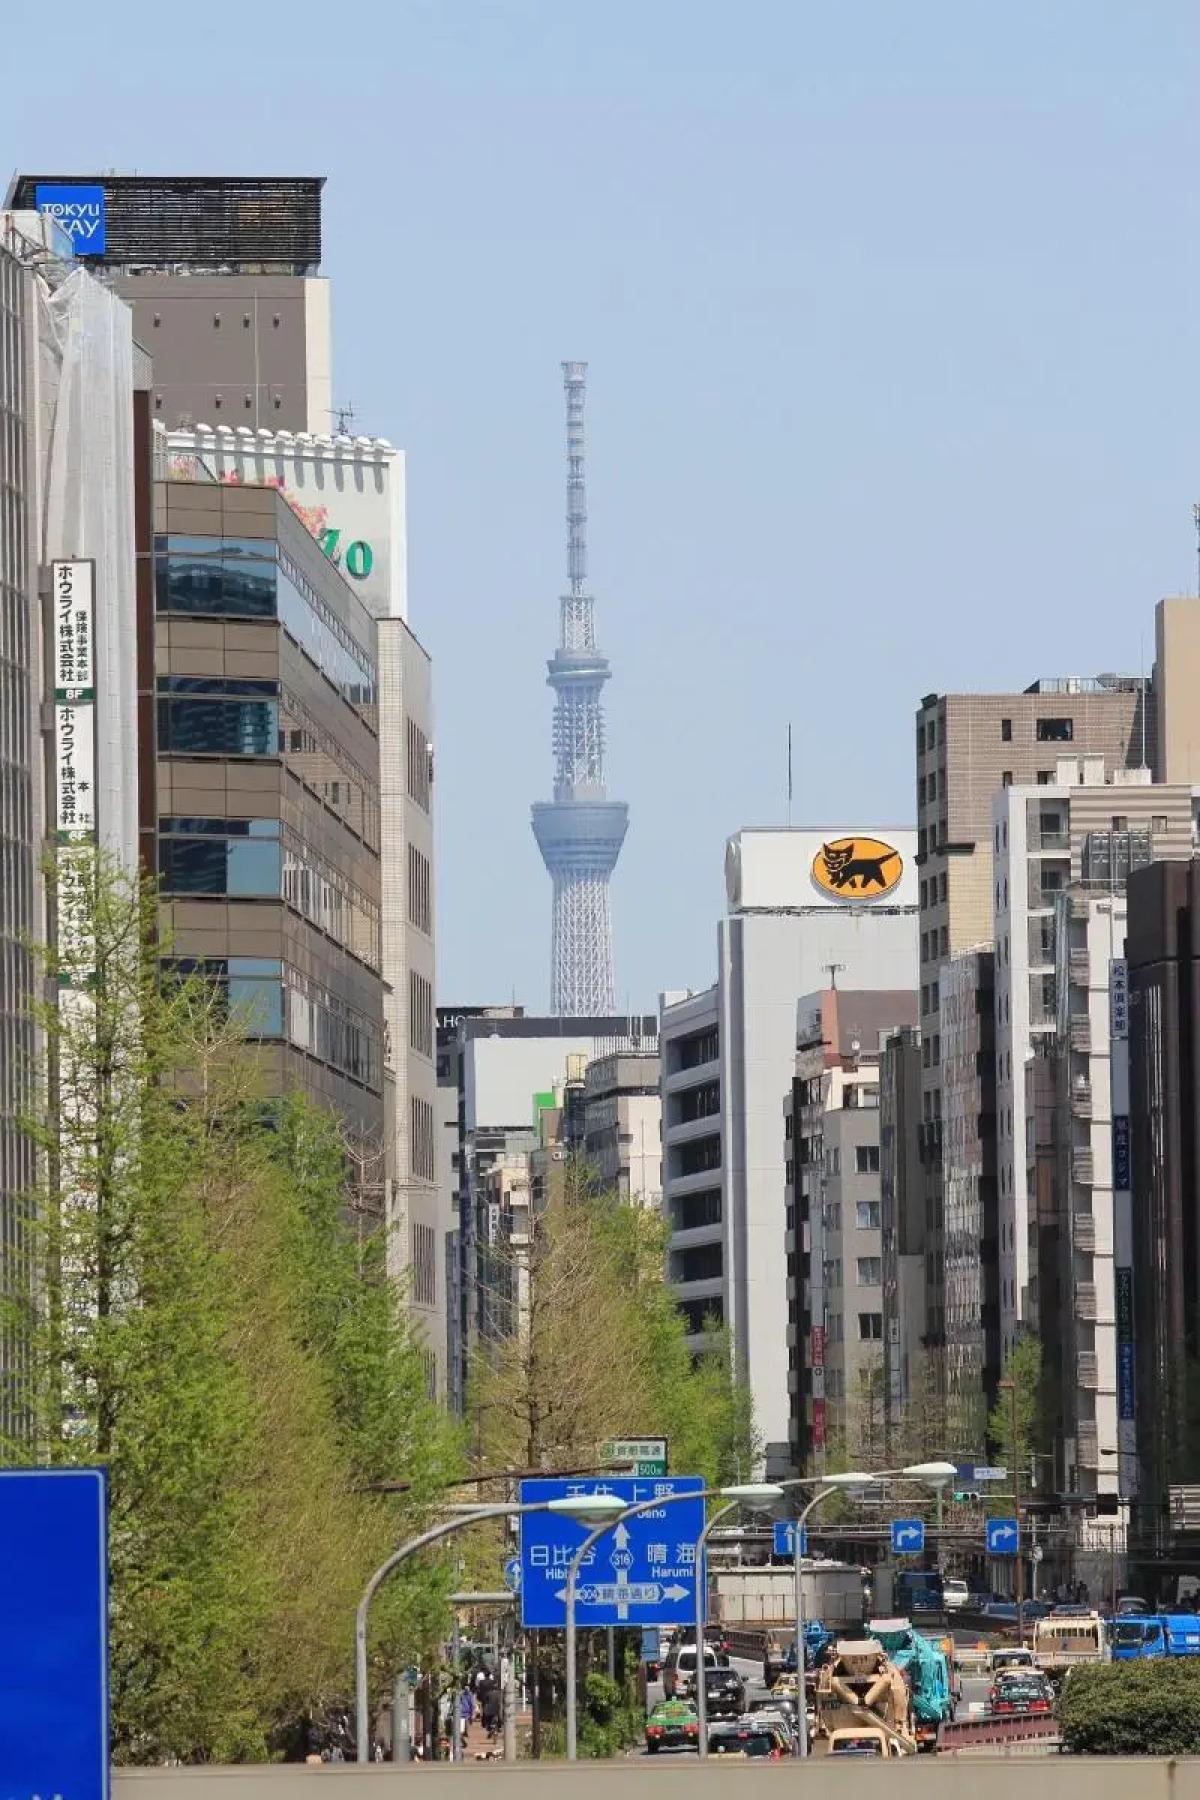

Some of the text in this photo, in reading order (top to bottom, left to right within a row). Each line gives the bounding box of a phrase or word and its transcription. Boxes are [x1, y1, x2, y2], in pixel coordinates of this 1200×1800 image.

[40, 203, 100, 218] TOKYU
[58, 565, 74, 682] ホウライ株式会社
[60, 707, 76, 824] ホウライ株式会社
[530, 1544, 597, 1567] 日比谷
[612, 1552, 632, 1566] 316
[646, 1543, 697, 1565] 晴海
[545, 1567, 582, 1580] Hibia
[651, 1565, 694, 1578] Harumi
